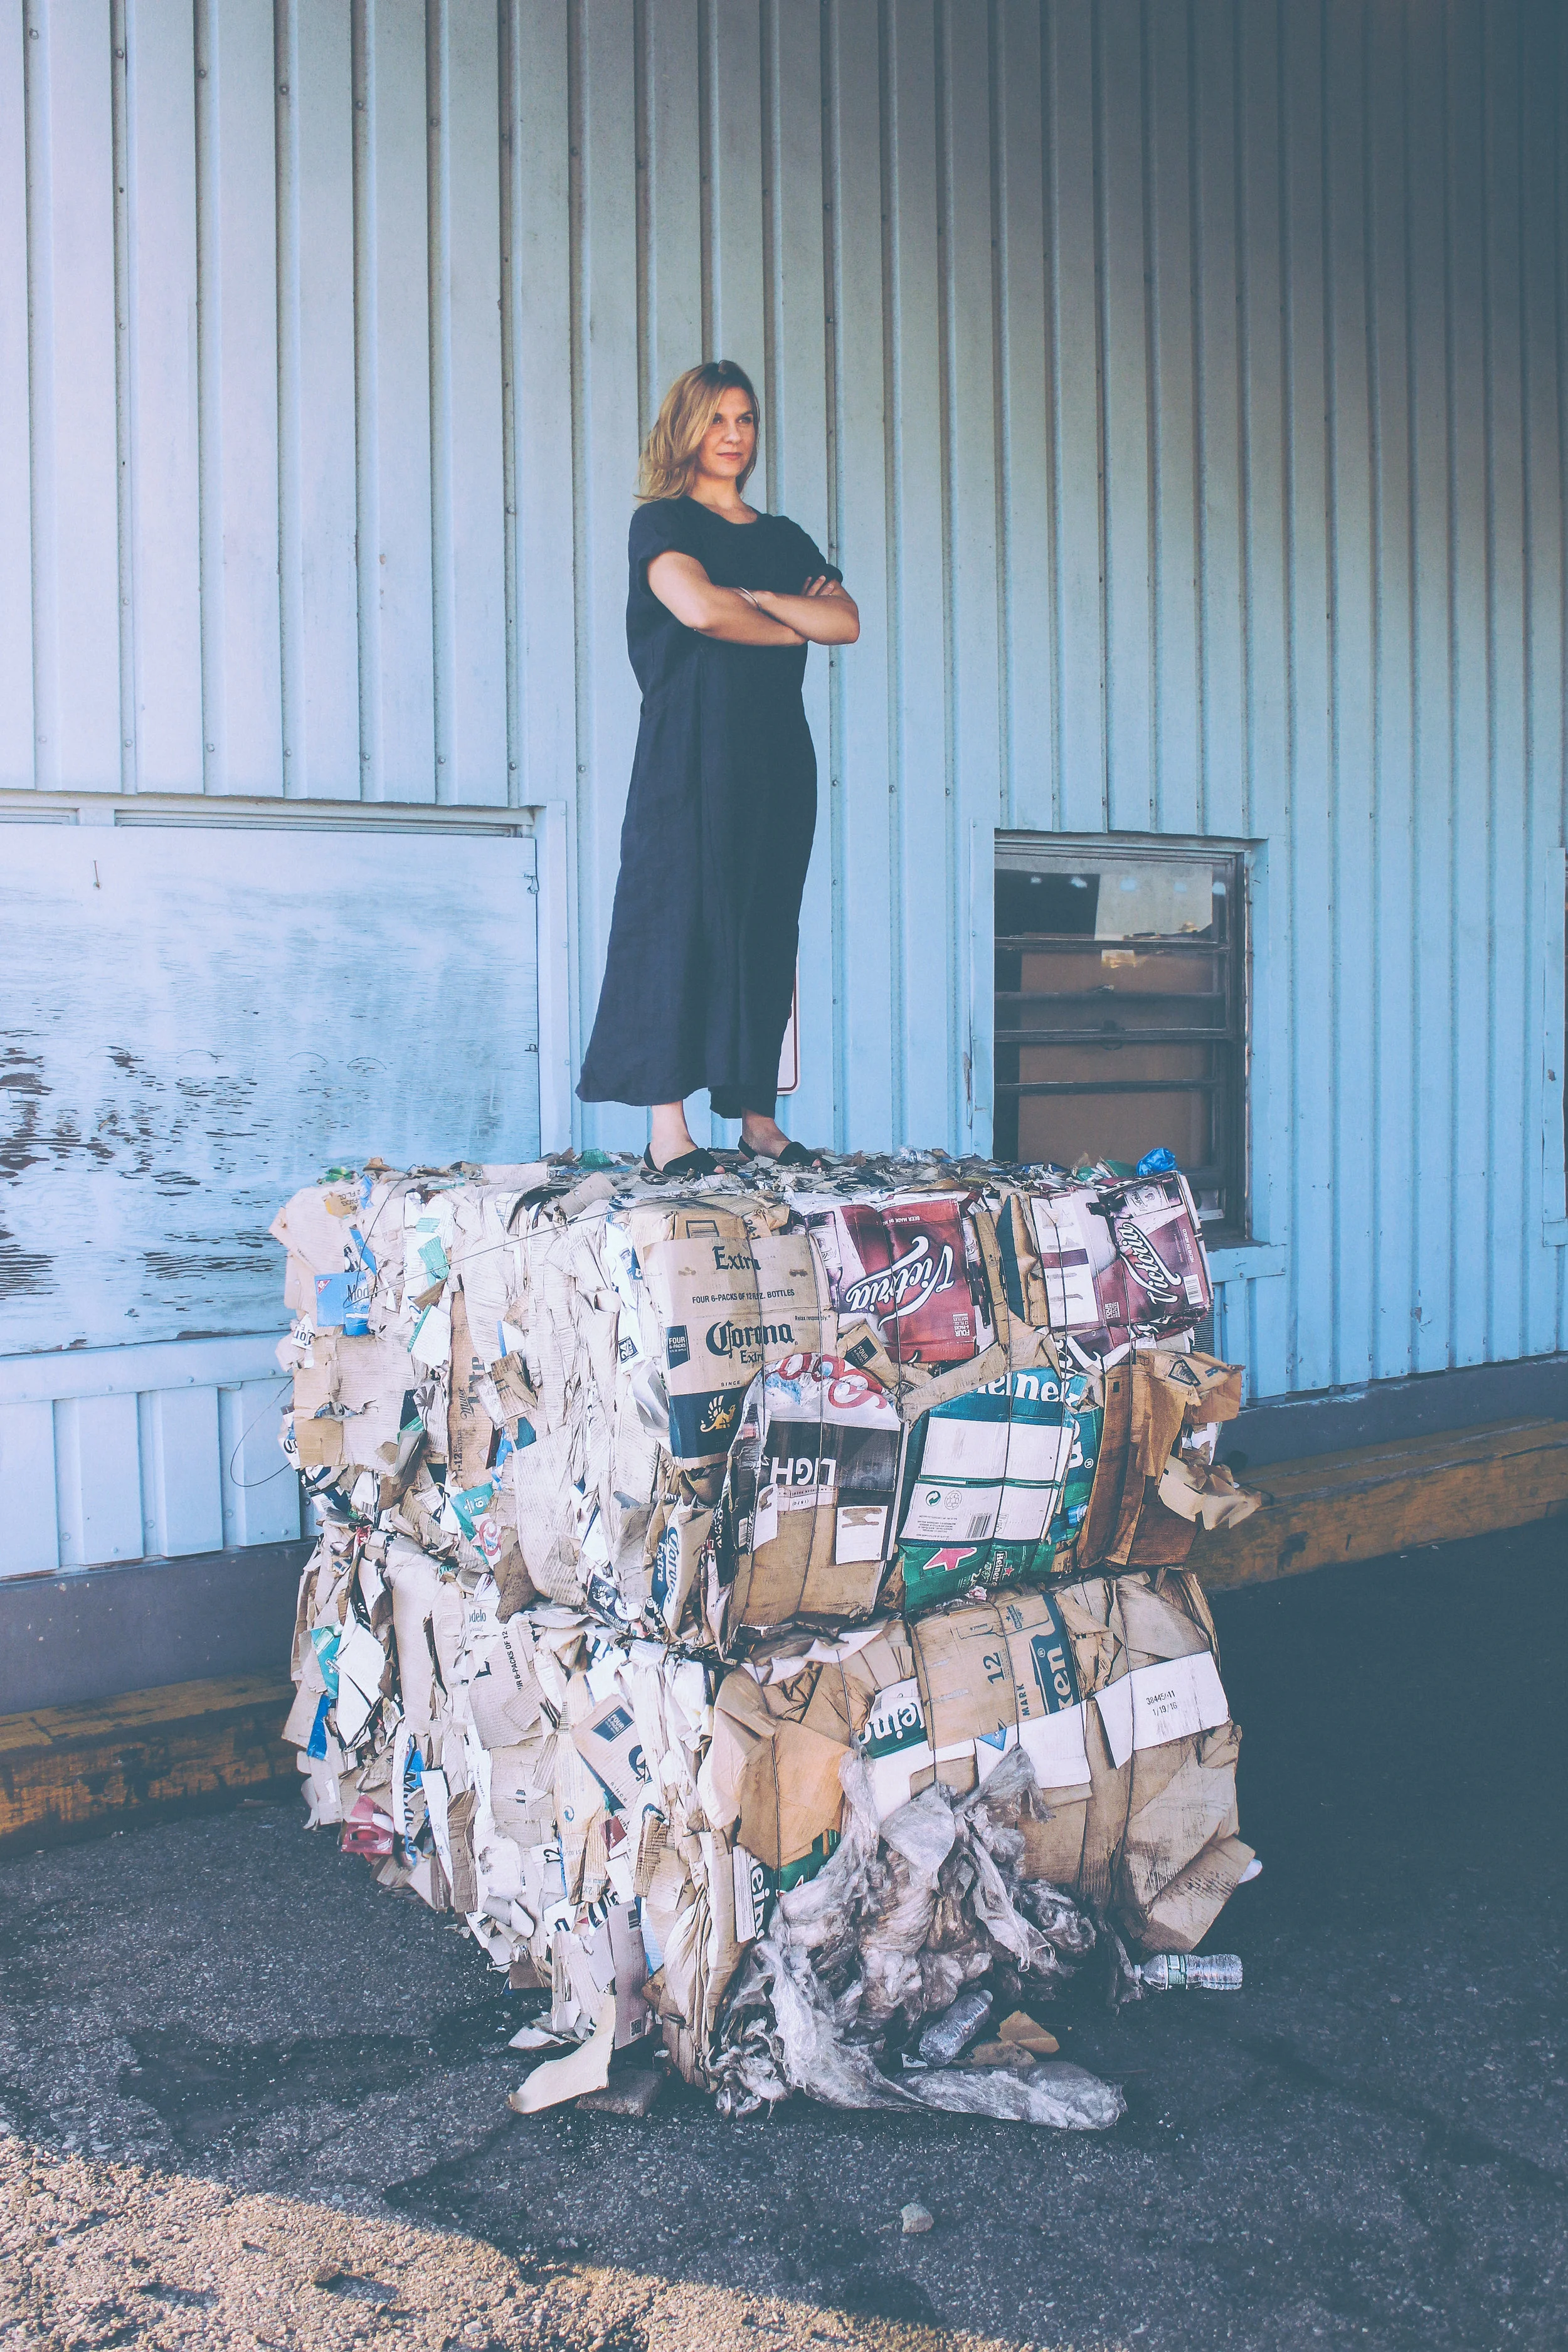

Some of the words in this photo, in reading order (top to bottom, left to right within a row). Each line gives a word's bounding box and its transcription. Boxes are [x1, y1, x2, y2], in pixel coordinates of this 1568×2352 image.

[1116, 1222, 1182, 1305] Victoria
[692, 1296, 709, 1304] FOUR
[711, 1292, 738, 1303] 6-PACKS
[738, 1292, 745, 1300] OF
[766, 1288, 795, 1299] BOTTLES
[669, 1336, 686, 1345] FOUR
[954, 1329, 970, 1337] FOUR
[857, 1345, 869, 1360] FOUR
[504, 1641, 512, 1650] OF
[507, 1651, 521, 1680] 6-PACKS
[983, 1651, 1005, 1685] 12
[1016, 1683, 1030, 1717] MARK
[1152, 1702, 1178, 1717] 1/19/16
[610, 1714, 625, 1730] FOUR
